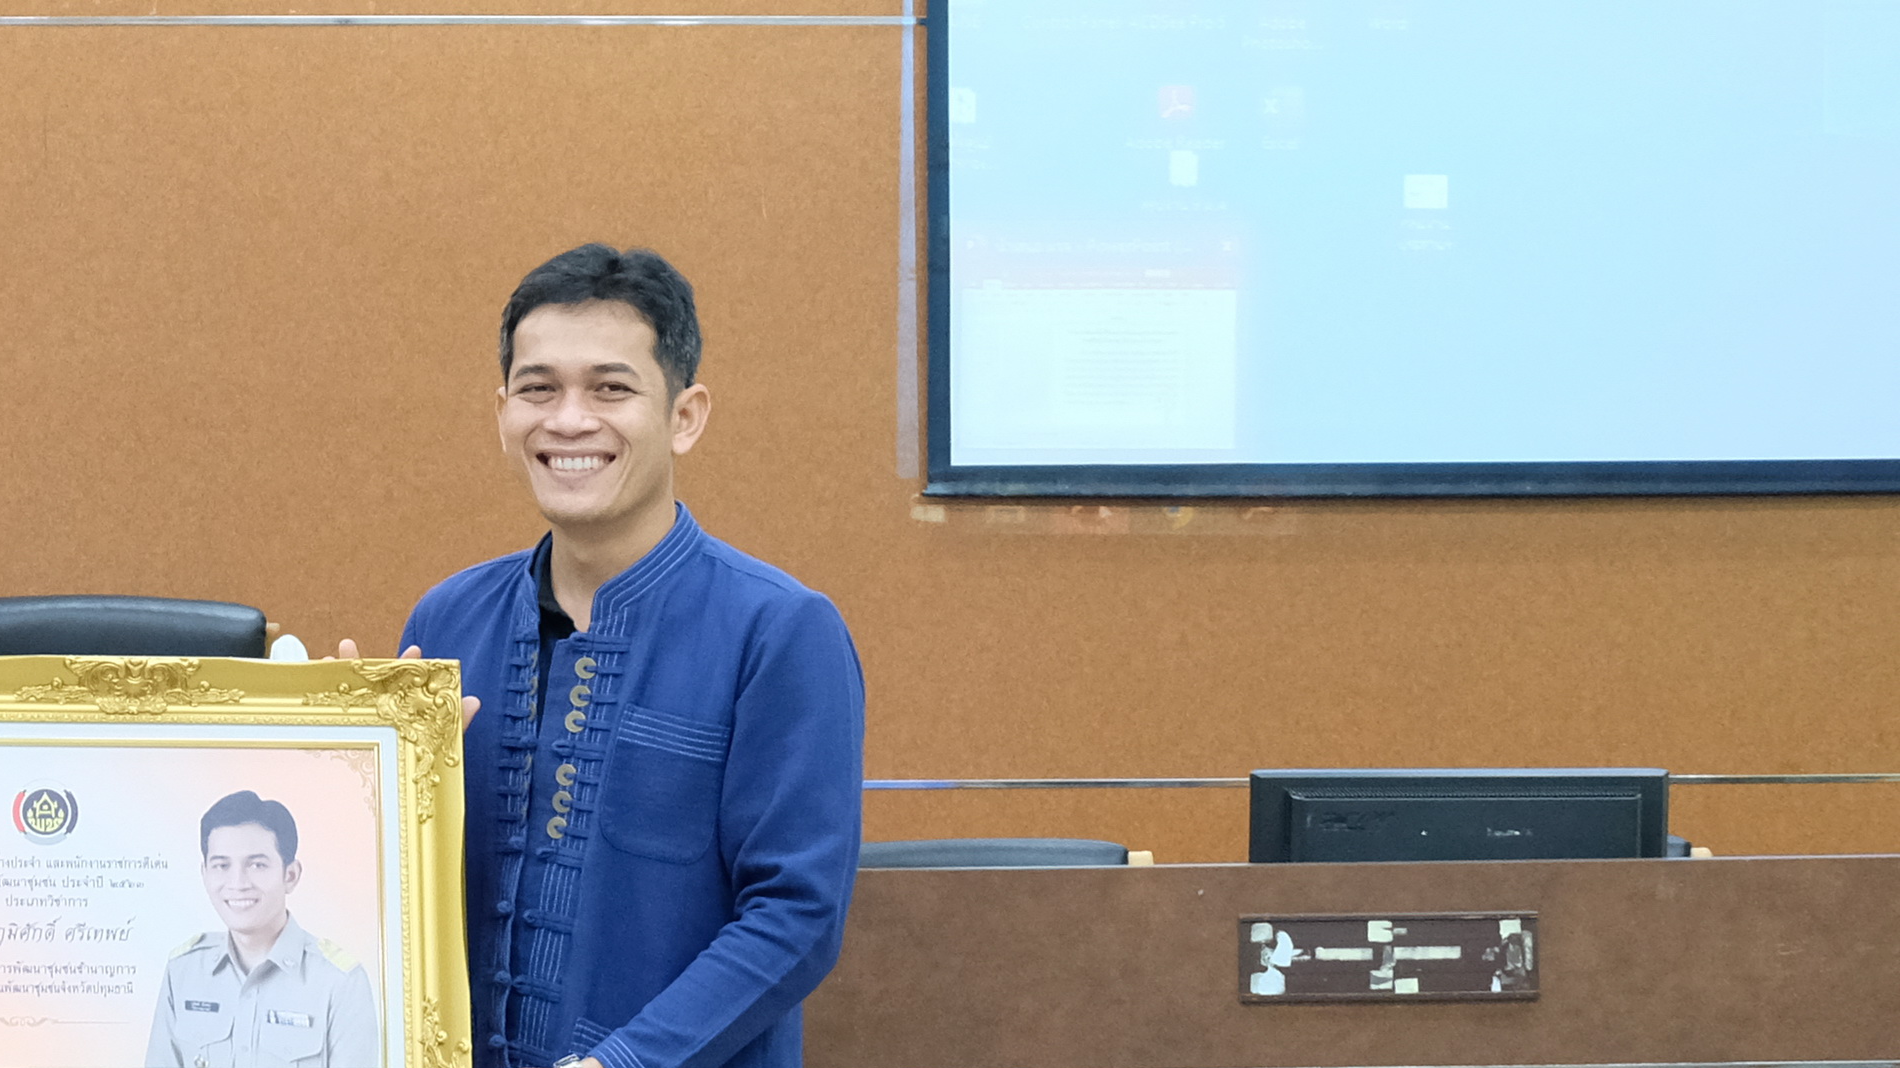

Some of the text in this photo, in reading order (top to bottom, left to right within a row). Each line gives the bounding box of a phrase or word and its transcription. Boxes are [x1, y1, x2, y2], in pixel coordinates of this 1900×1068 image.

[46, 854, 168, 870] และพนักงานราชการดีเด่น
[62, 876, 103, 888] ประจำปี
[5, 894, 88, 907] ประเภทวิชาการ
[65, 916, 136, 942] ศรีเทพย์
